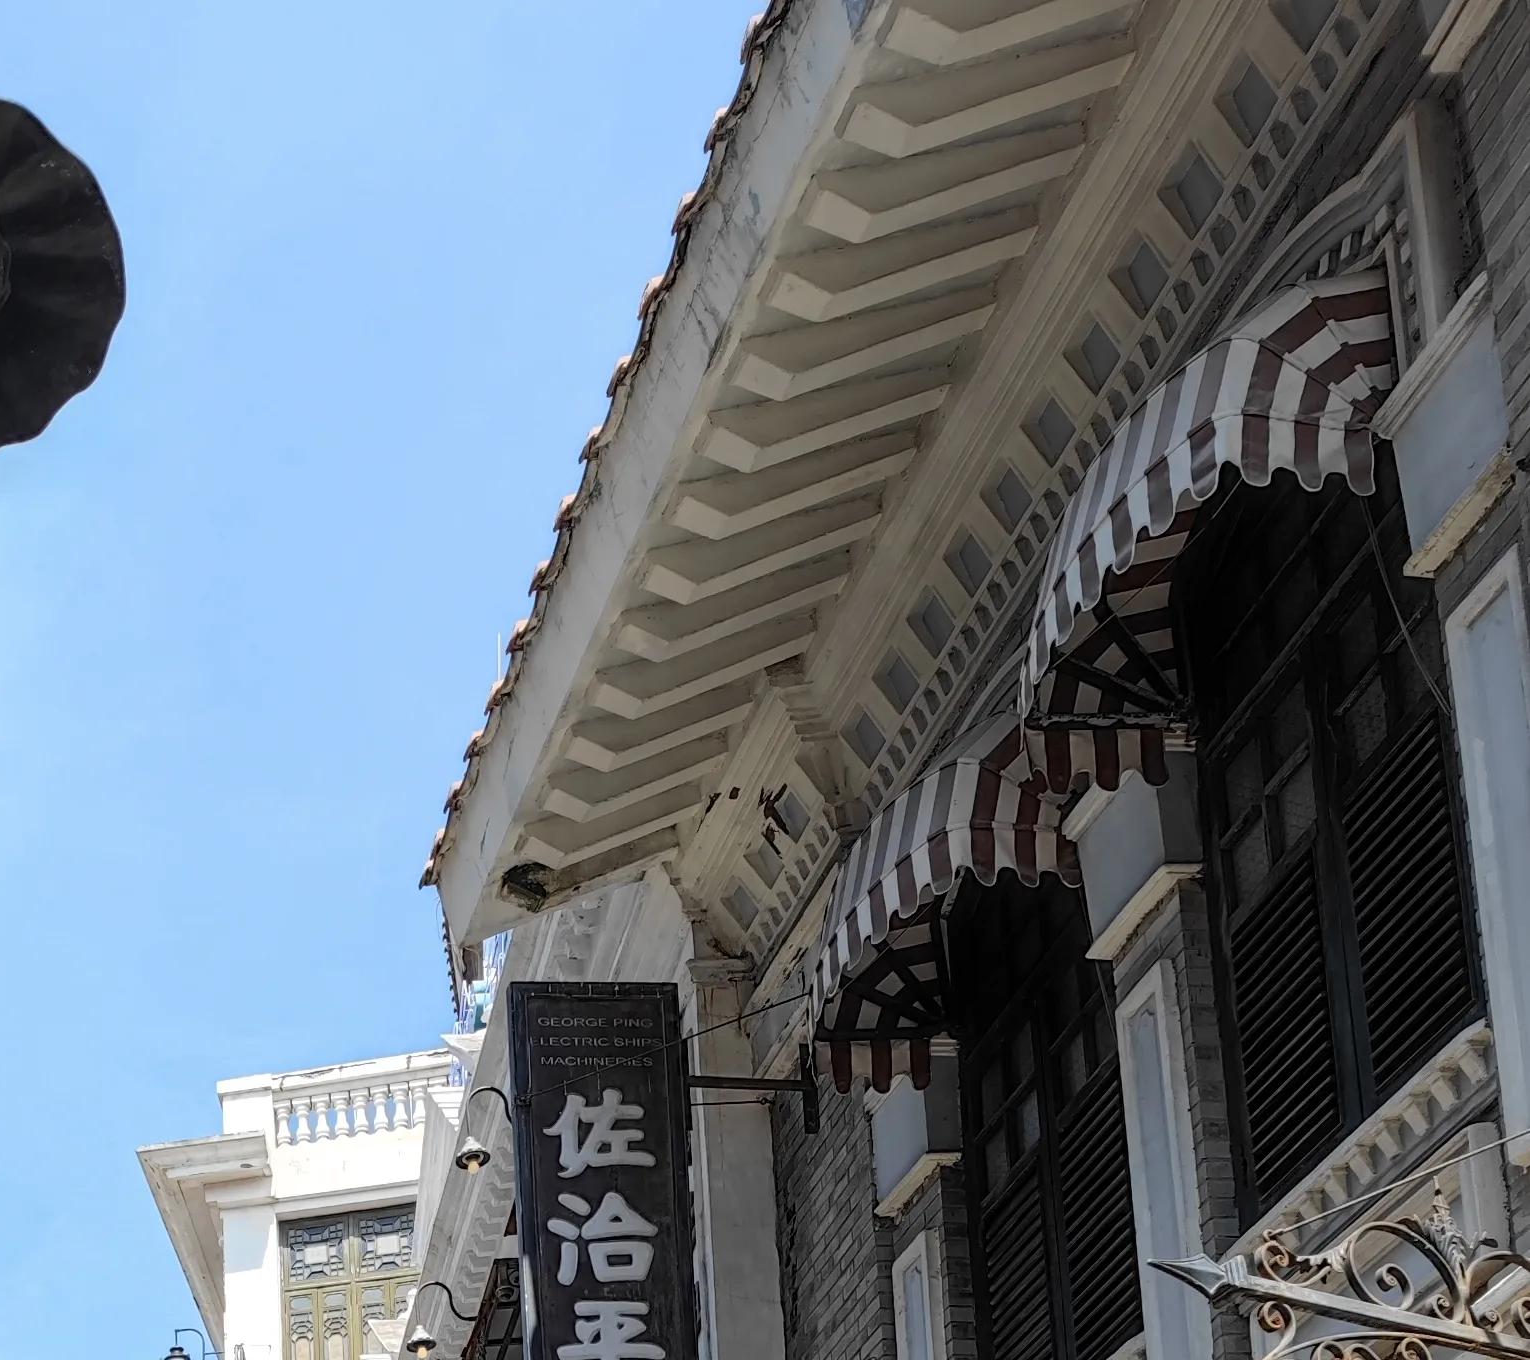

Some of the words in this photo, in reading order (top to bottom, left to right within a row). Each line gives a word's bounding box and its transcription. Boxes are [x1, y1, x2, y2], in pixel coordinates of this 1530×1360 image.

[537, 1016, 608, 1028] GEORGE
[613, 1017, 654, 1028] PING
[614, 1037, 663, 1048] SHIPS
